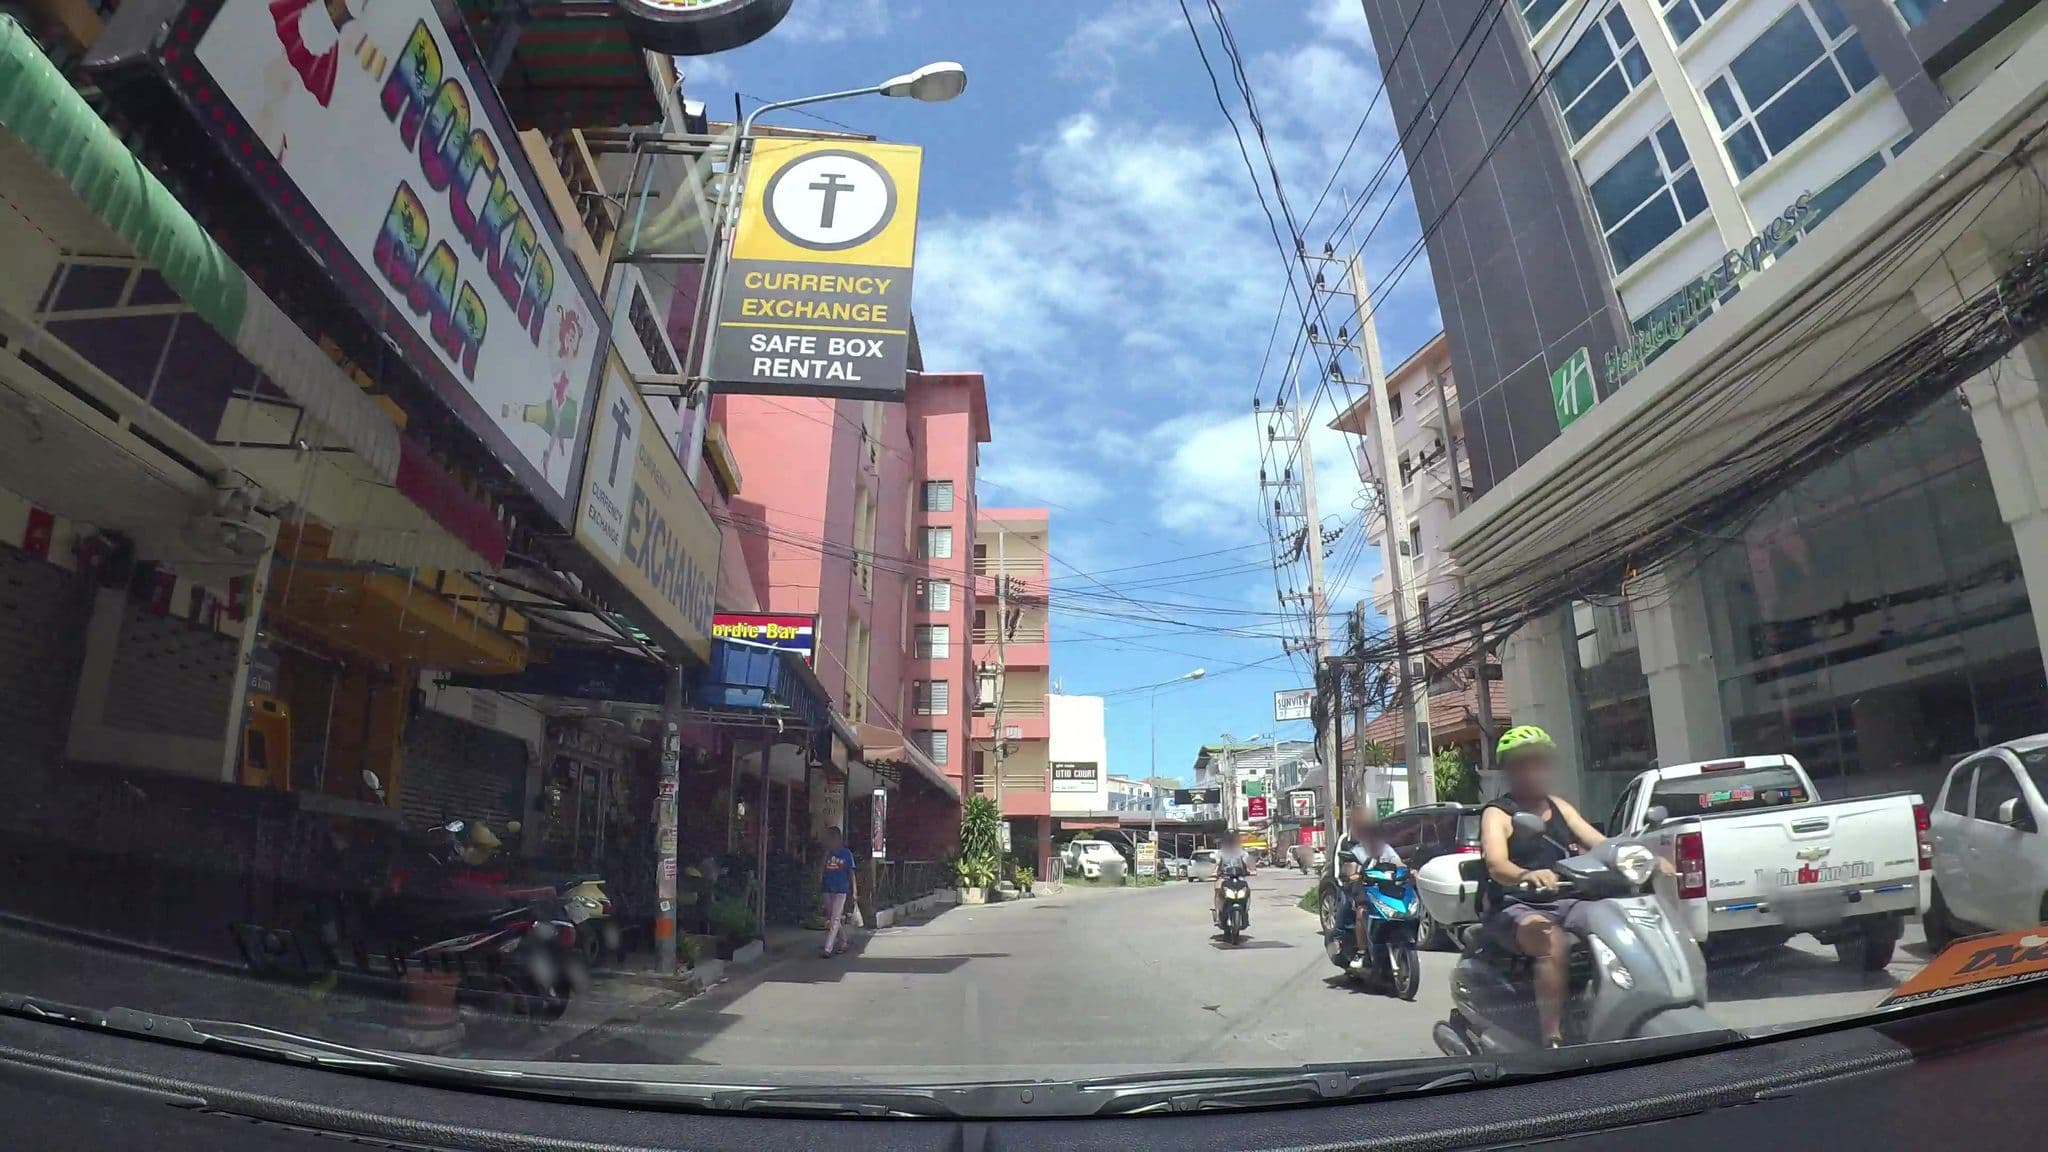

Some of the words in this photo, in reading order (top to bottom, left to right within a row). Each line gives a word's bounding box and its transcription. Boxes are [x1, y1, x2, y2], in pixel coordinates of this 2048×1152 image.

[380, 18, 554, 348] ROCKER
[1722, 191, 1811, 282] Express
[372, 179, 488, 382] BAR
[744, 271, 892, 296] CURRENCY
[741, 297, 888, 323] EXCHANGE
[750, 333, 817, 356] SAFE
[828, 336, 884, 358] BOX
[752, 357, 861, 381] RENTAL
[591, 481, 624, 526] CURRENCY
[587, 503, 620, 547] EXCHANGE
[624, 480, 715, 638] EXCHANGE
[766, 622, 800, 640] Bar
[1277, 694, 1310, 709] SUNVIEW
